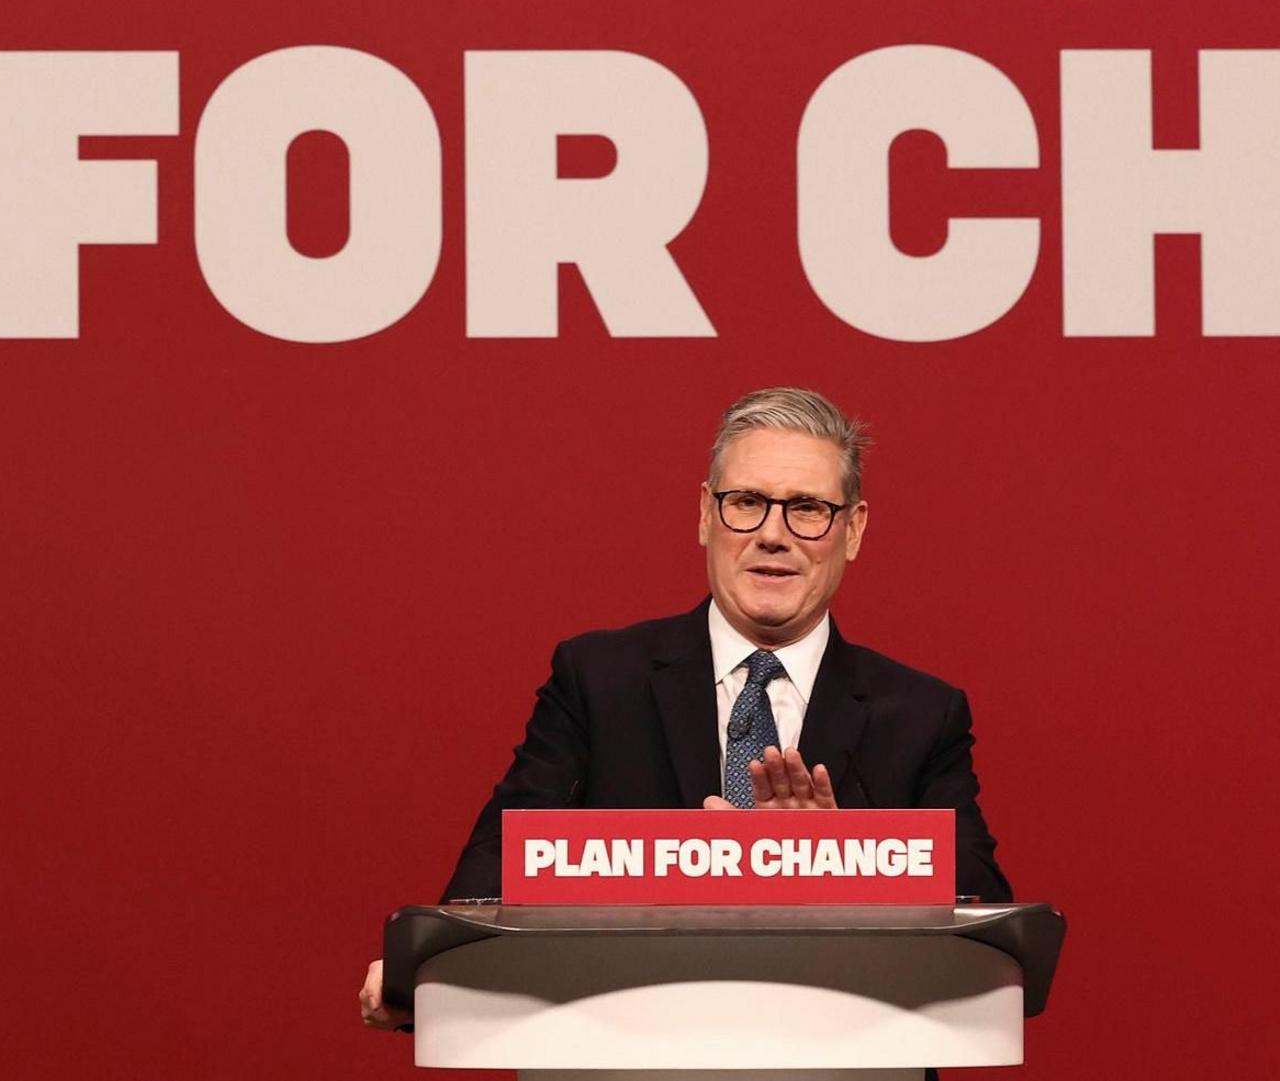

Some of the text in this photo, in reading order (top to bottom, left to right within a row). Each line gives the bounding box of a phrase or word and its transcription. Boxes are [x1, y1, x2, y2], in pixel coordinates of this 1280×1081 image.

[524, 838, 934, 877] PLAN FOR CHANGE
